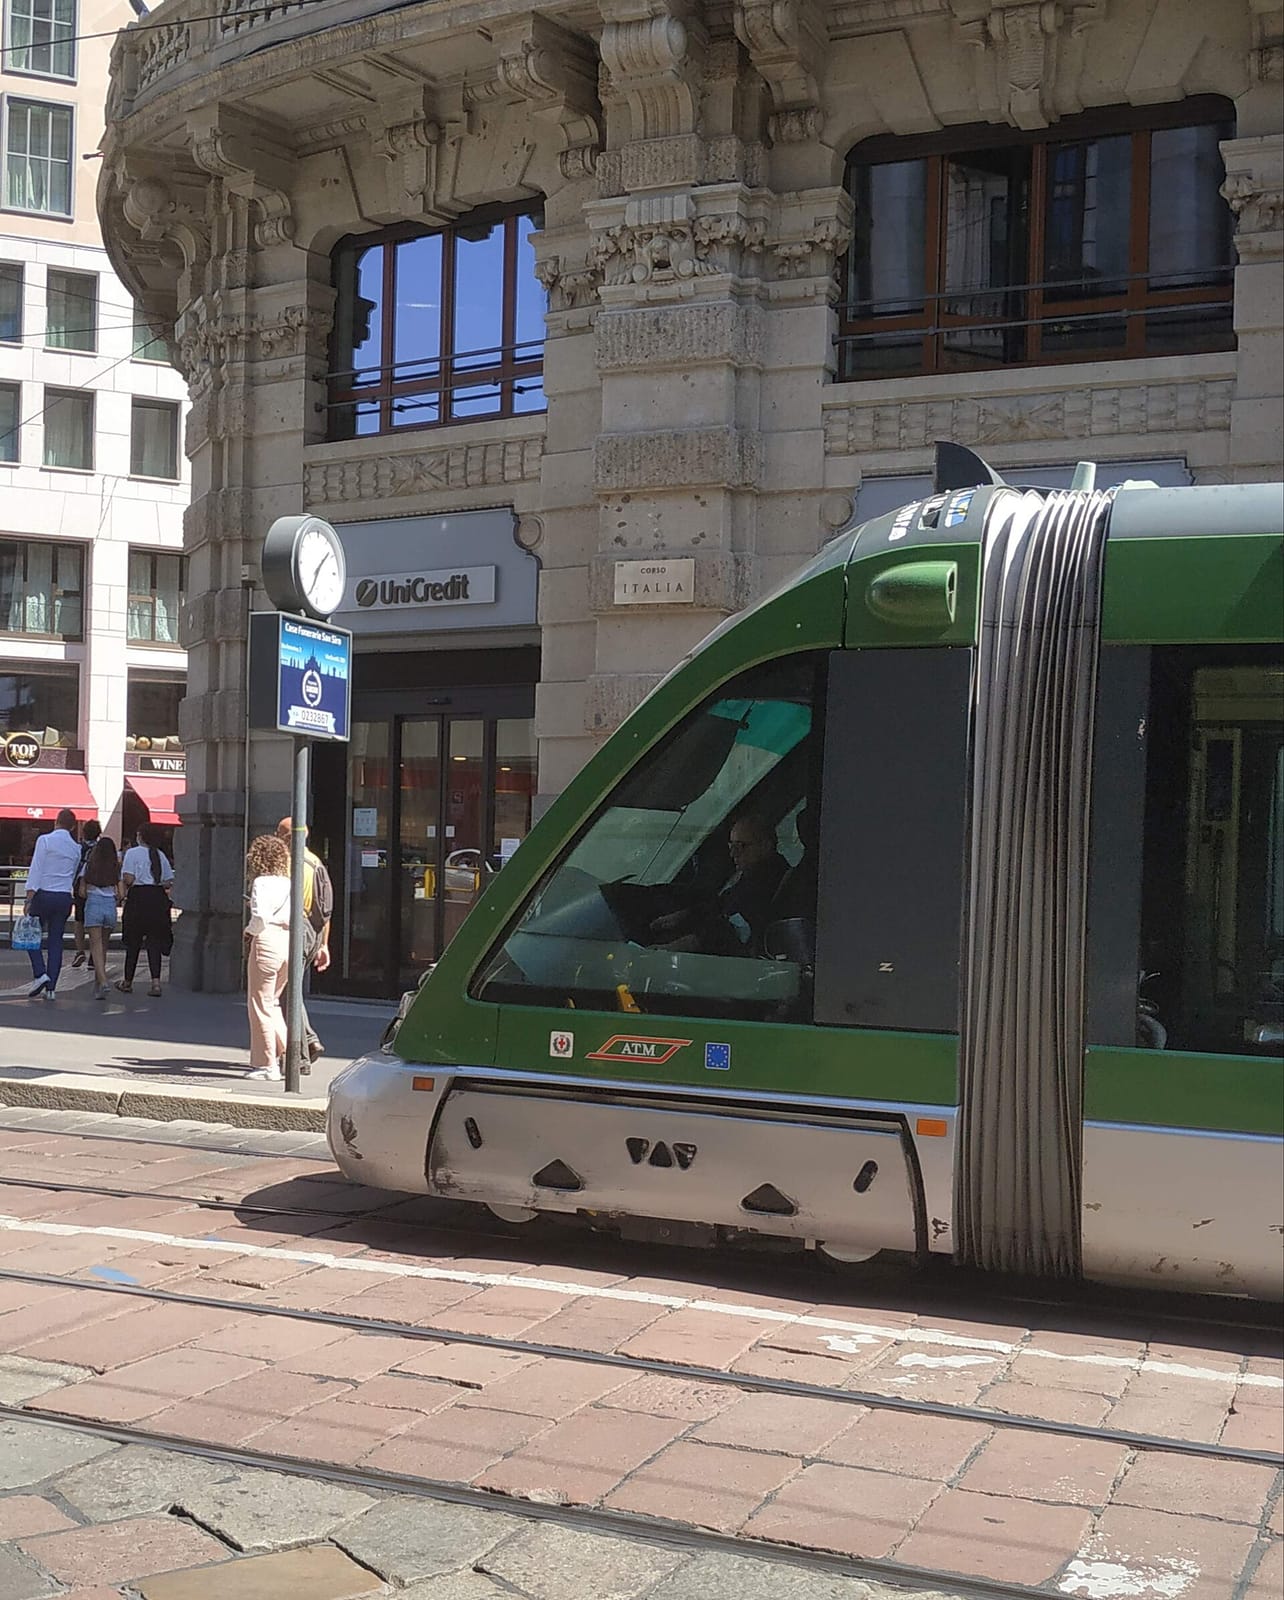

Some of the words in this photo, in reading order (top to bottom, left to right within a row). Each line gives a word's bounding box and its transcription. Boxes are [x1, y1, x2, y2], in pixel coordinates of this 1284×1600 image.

[640, 567, 666, 575] CORSO
[380, 574, 470, 605] UniCredit
[623, 582, 683, 593] ITALIA
[9, 743, 38, 758] TOP
[151, 758, 183, 771] WINE
[621, 1042, 657, 1057] ATM
